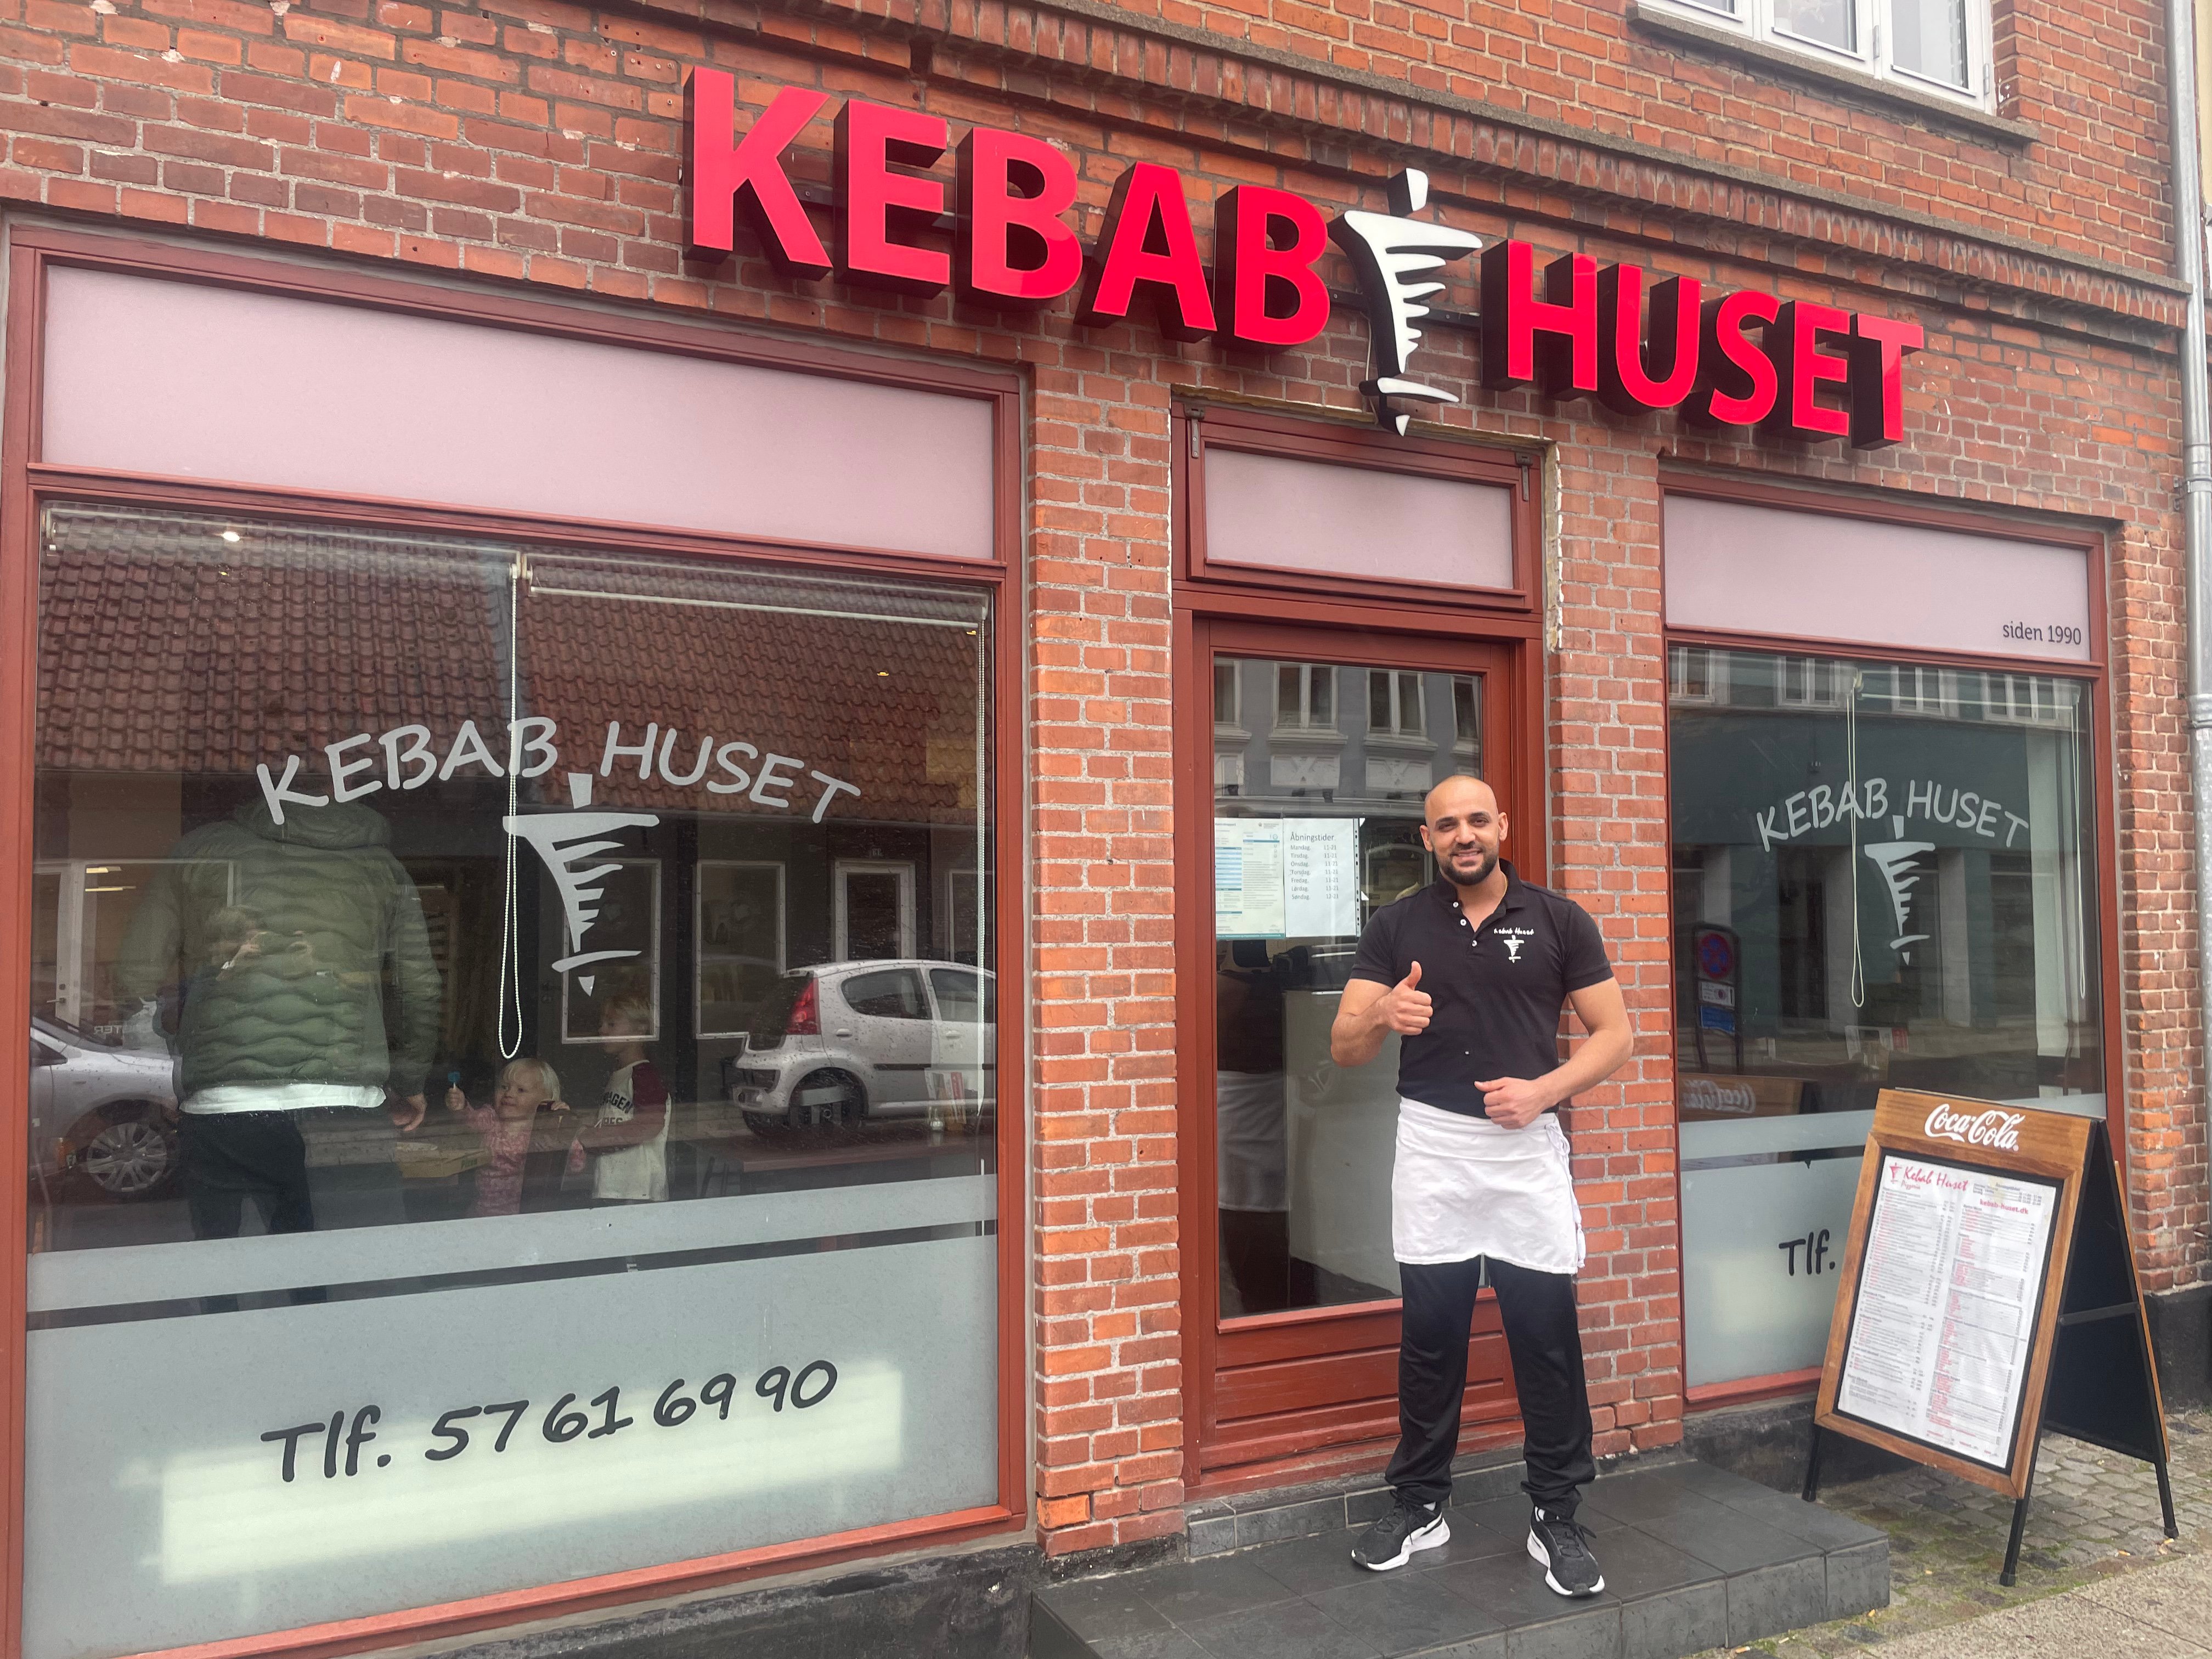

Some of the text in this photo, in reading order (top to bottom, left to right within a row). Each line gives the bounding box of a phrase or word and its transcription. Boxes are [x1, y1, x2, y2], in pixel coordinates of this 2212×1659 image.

[686, 66, 1924, 442] KEBAB HUSET
[2002, 621, 2081, 645] siden 1990
[256, 716, 862, 826] KEBAB HUSET
[1756, 777, 2029, 852] KEBAB HUSET
[1924, 1103, 2026, 1150] Coca-Cola
[1903, 1166, 1968, 1191] Kebab Huset
[1979, 1199, 2029, 1215] kebab-huset.dk
[1778, 1228, 1836, 1277] Tlf.
[260, 1359, 839, 1483] Tlf. 57 61 69 90
